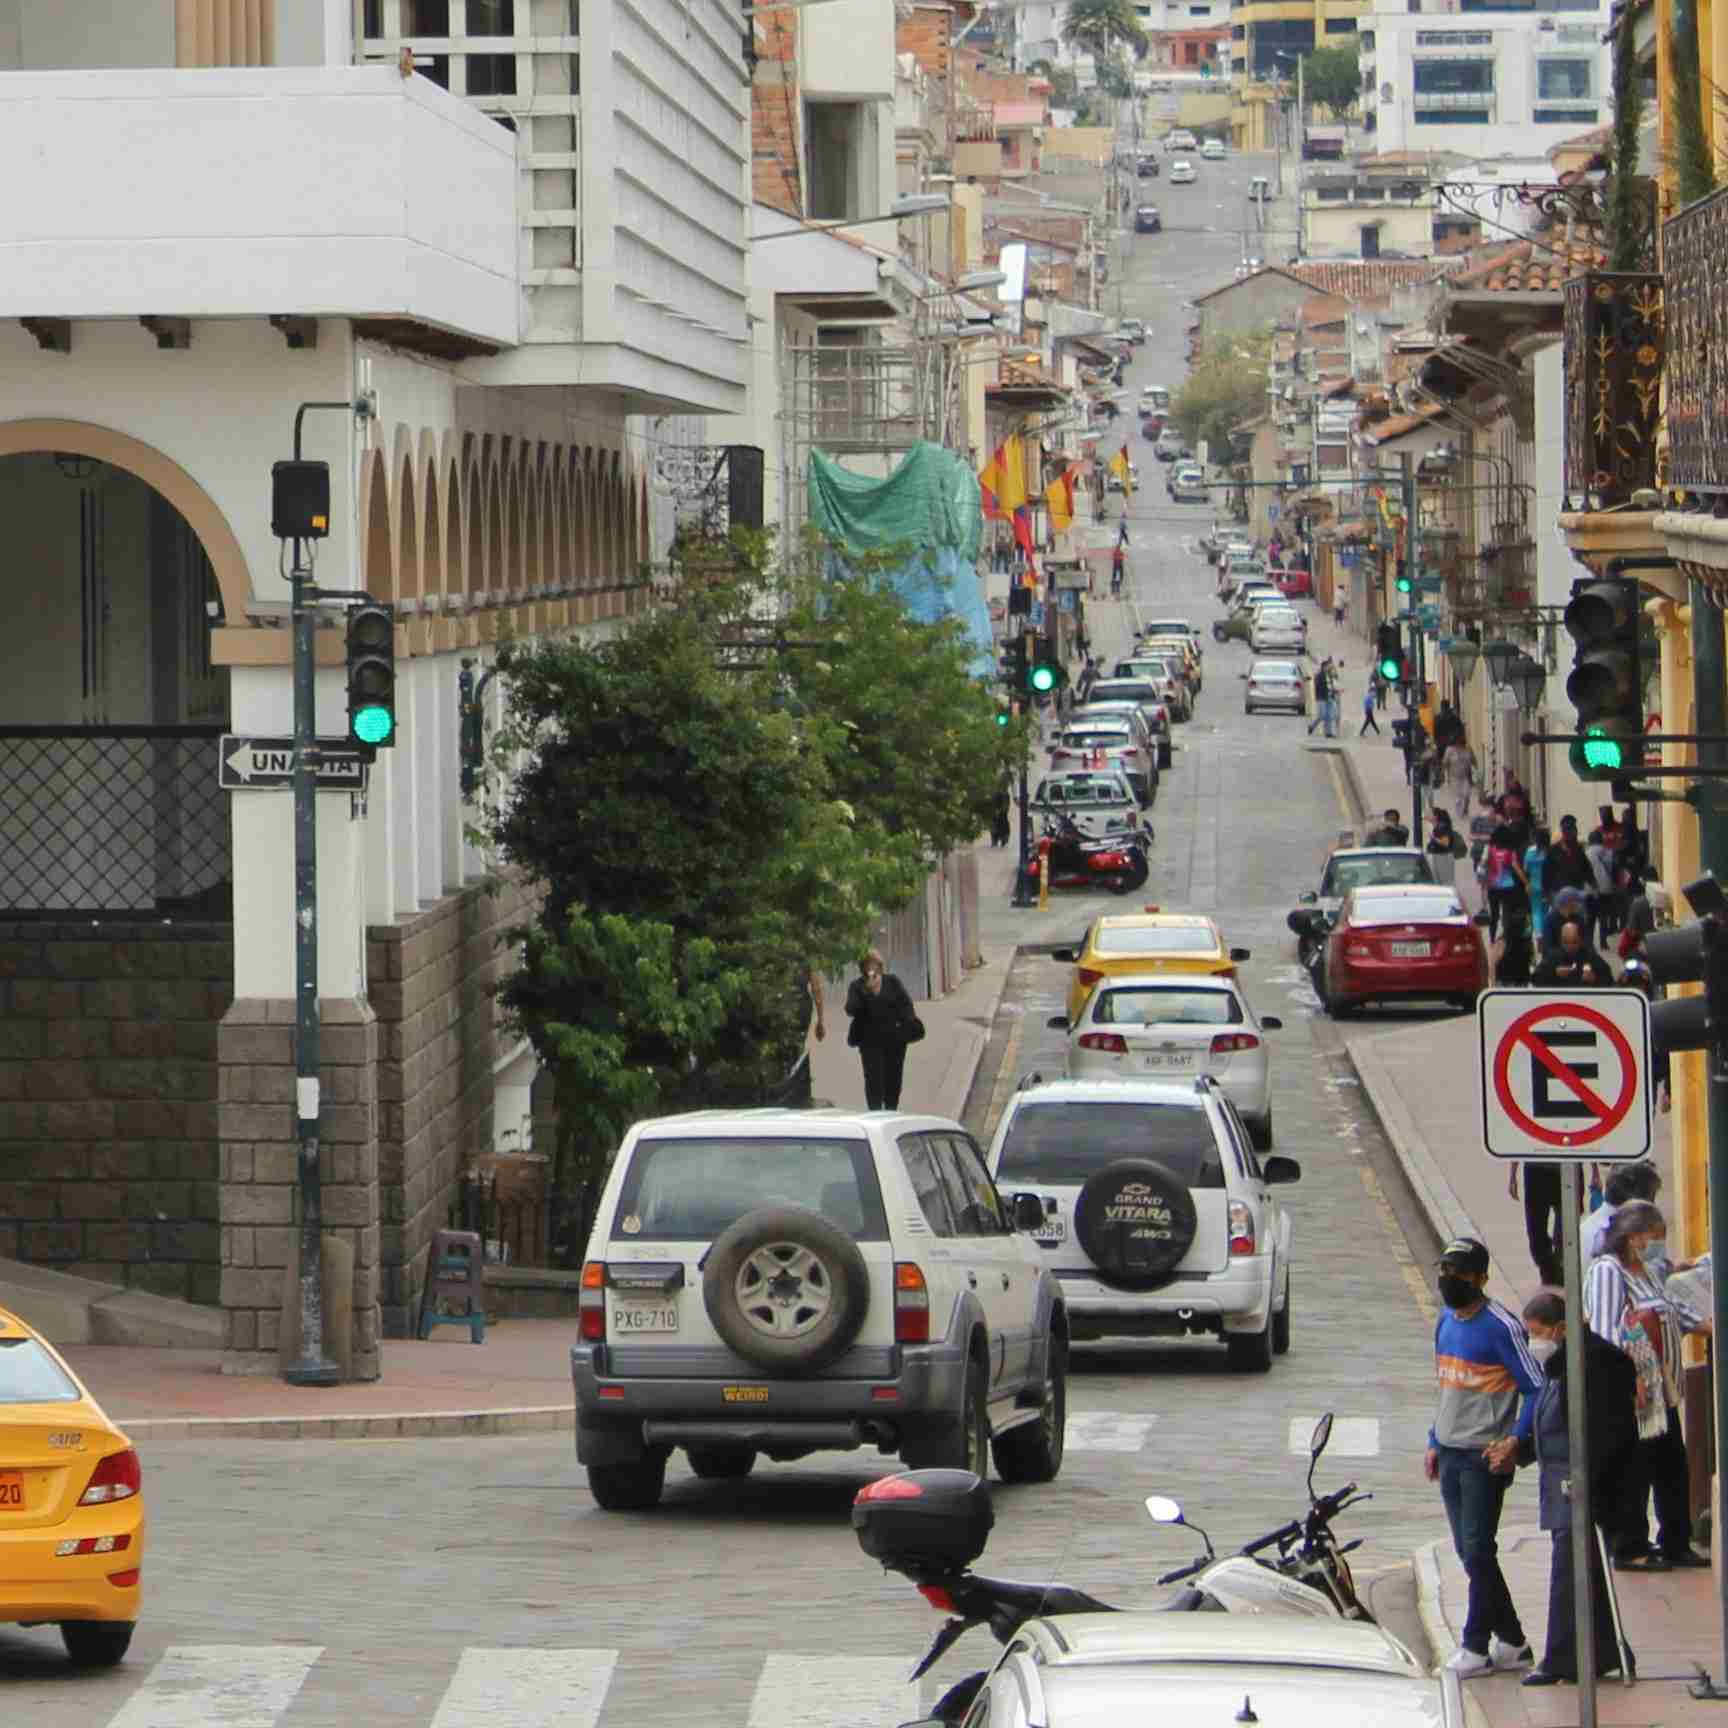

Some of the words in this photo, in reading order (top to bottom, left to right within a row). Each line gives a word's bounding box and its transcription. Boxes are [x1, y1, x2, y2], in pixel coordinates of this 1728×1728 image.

[252, 752, 300, 773] UN
[1114, 1193, 1163, 1206] GRAND
[1104, 1205, 1172, 1222] VITARA
[614, 1310, 677, 1329] PXG-710
